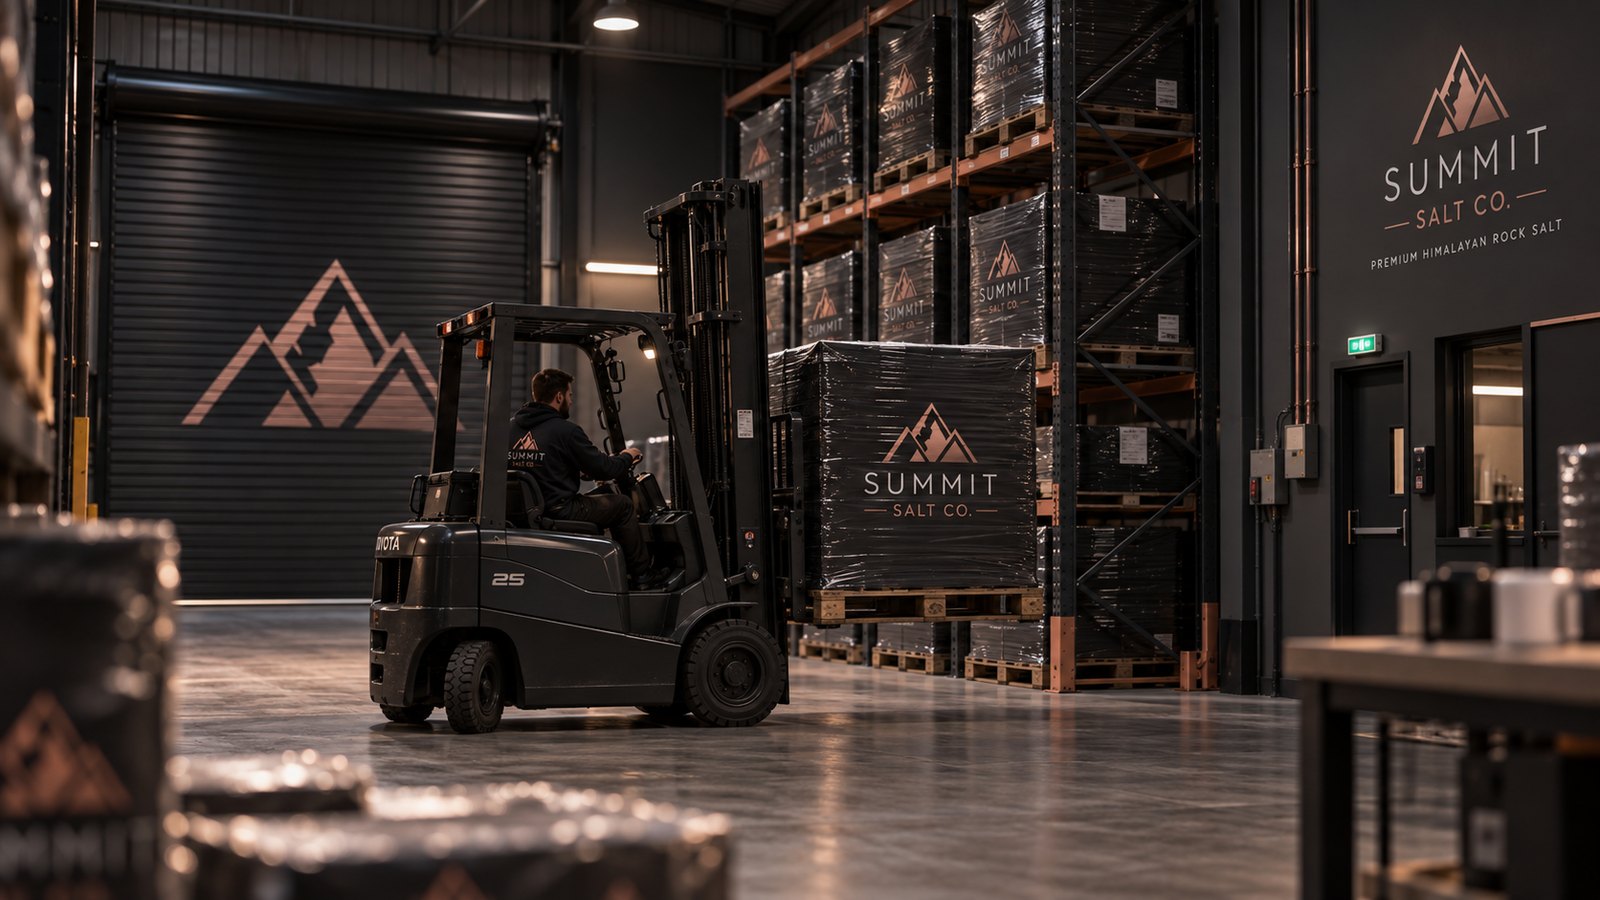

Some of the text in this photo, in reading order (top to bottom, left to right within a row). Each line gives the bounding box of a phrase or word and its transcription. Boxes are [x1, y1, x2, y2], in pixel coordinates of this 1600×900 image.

[979, 37, 1031, 75] SUMMIT
[880, 91, 925, 122] SUMMIT
[808, 129, 843, 157] SUMMIT
[1384, 125, 1547, 202] SUMMIT
[1416, 190, 1511, 230] SALT CO.
[1371, 218, 1562, 270] PREMIUM HIMALAYAN ROCK SALT
[979, 276, 1031, 303] SUMMIT
[883, 299, 923, 322] SUMMIT
[988, 299, 1019, 315] SALT CO.
[808, 317, 843, 338] SUMMIT
[508, 451, 546, 461] SUMMIT
[863, 472, 998, 496] SUMMIT
[893, 503, 972, 517] SALT CO.
[491, 572, 526, 587] 25
